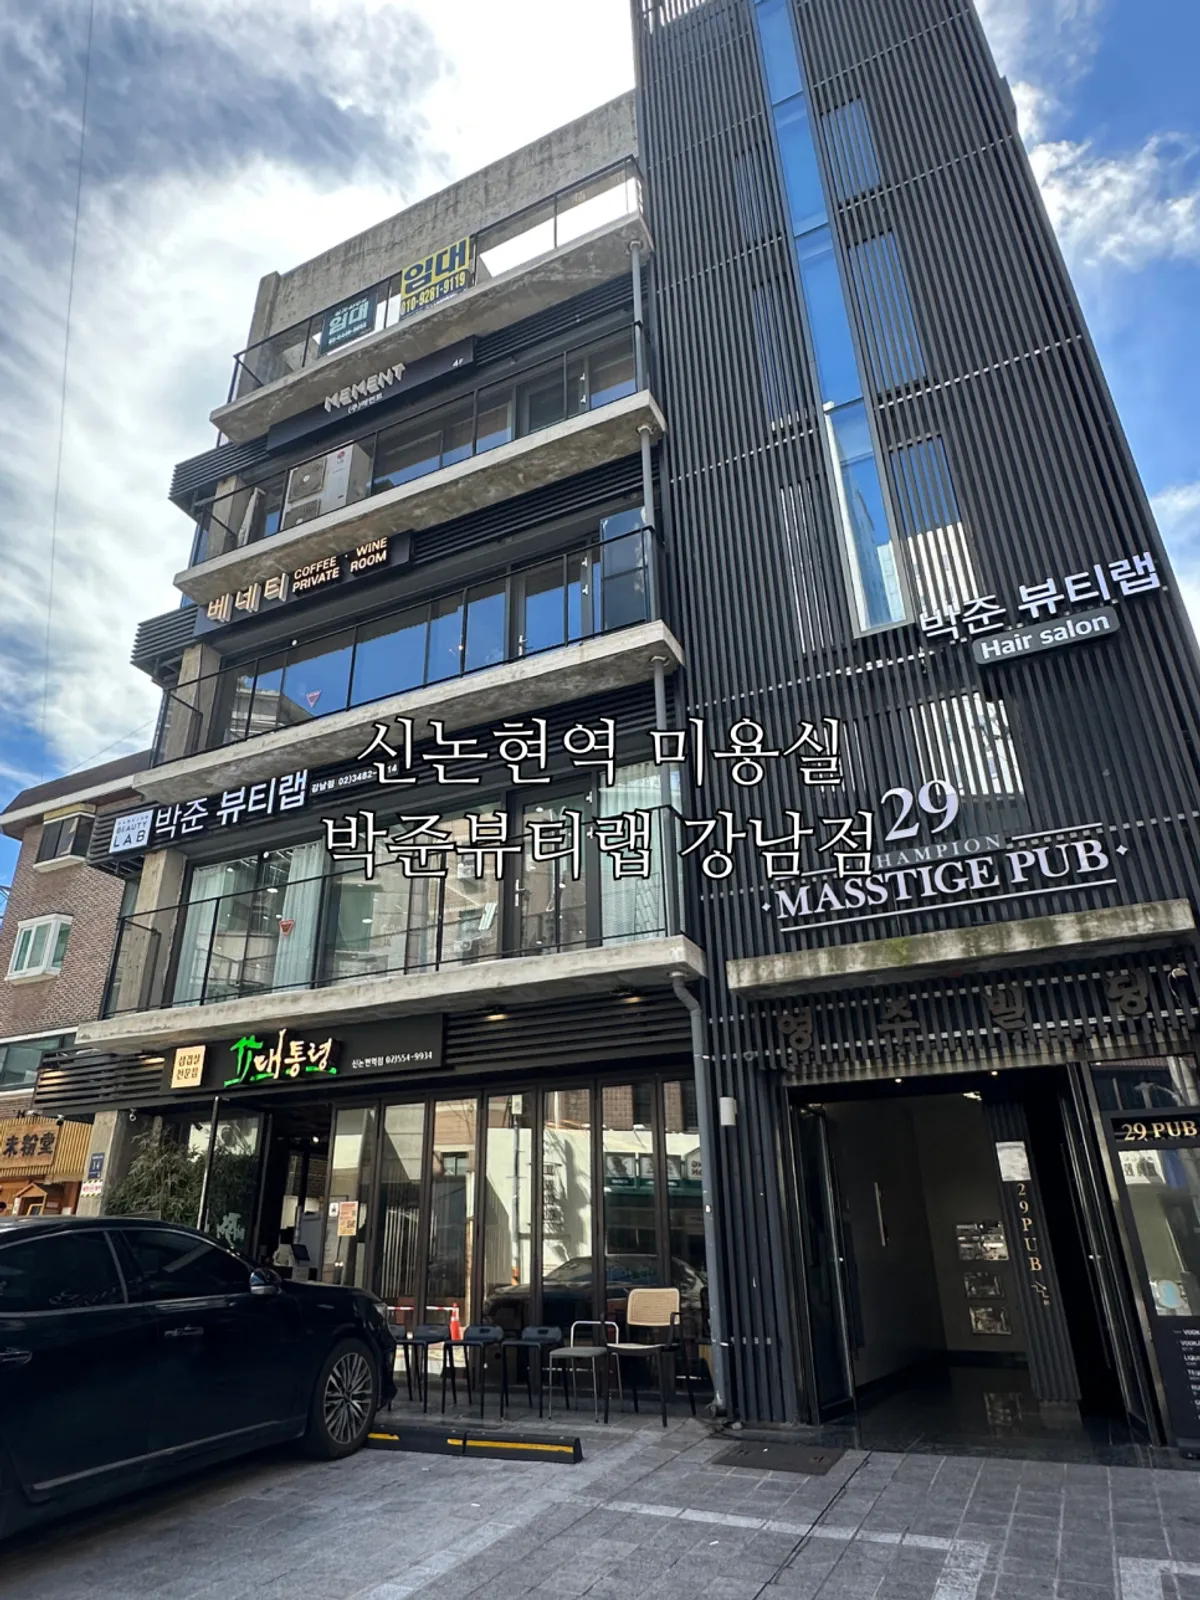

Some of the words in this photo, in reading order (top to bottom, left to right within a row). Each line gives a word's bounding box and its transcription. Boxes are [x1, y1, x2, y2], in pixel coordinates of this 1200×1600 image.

[404, 239, 467, 295] 임대
[400, 271, 466, 316] 010-9281-9119
[329, 300, 369, 336] 임대
[291, 567, 341, 593] PRIVATE
[350, 549, 388, 573] ROOM
[294, 556, 337, 580] COFFEE
[356, 536, 388, 557] WINE
[206, 572, 290, 623] 베네티
[919, 593, 1007, 641] 박준
[1017, 550, 1161, 620] 뷰티랩
[980, 633, 1034, 660] Hair
[1039, 613, 1111, 646] salon
[338, 763, 398, 786] 02)3482-14
[155, 797, 209, 839] 박준
[215, 768, 309, 827] 뷰티랩
[880, 779, 960, 842] 29
[113, 829, 146, 848] LAB
[116, 820, 148, 835] BEAUTY
[870, 834, 1002, 869] HAMPION
[776, 856, 1001, 920] MASSTIGE
[1006, 838, 1110, 885] PUB
[253, 1028, 333, 1079] 대통령
[1121, 1122, 1148, 1141] 29
[1151, 1120, 1198, 1138] PUB
